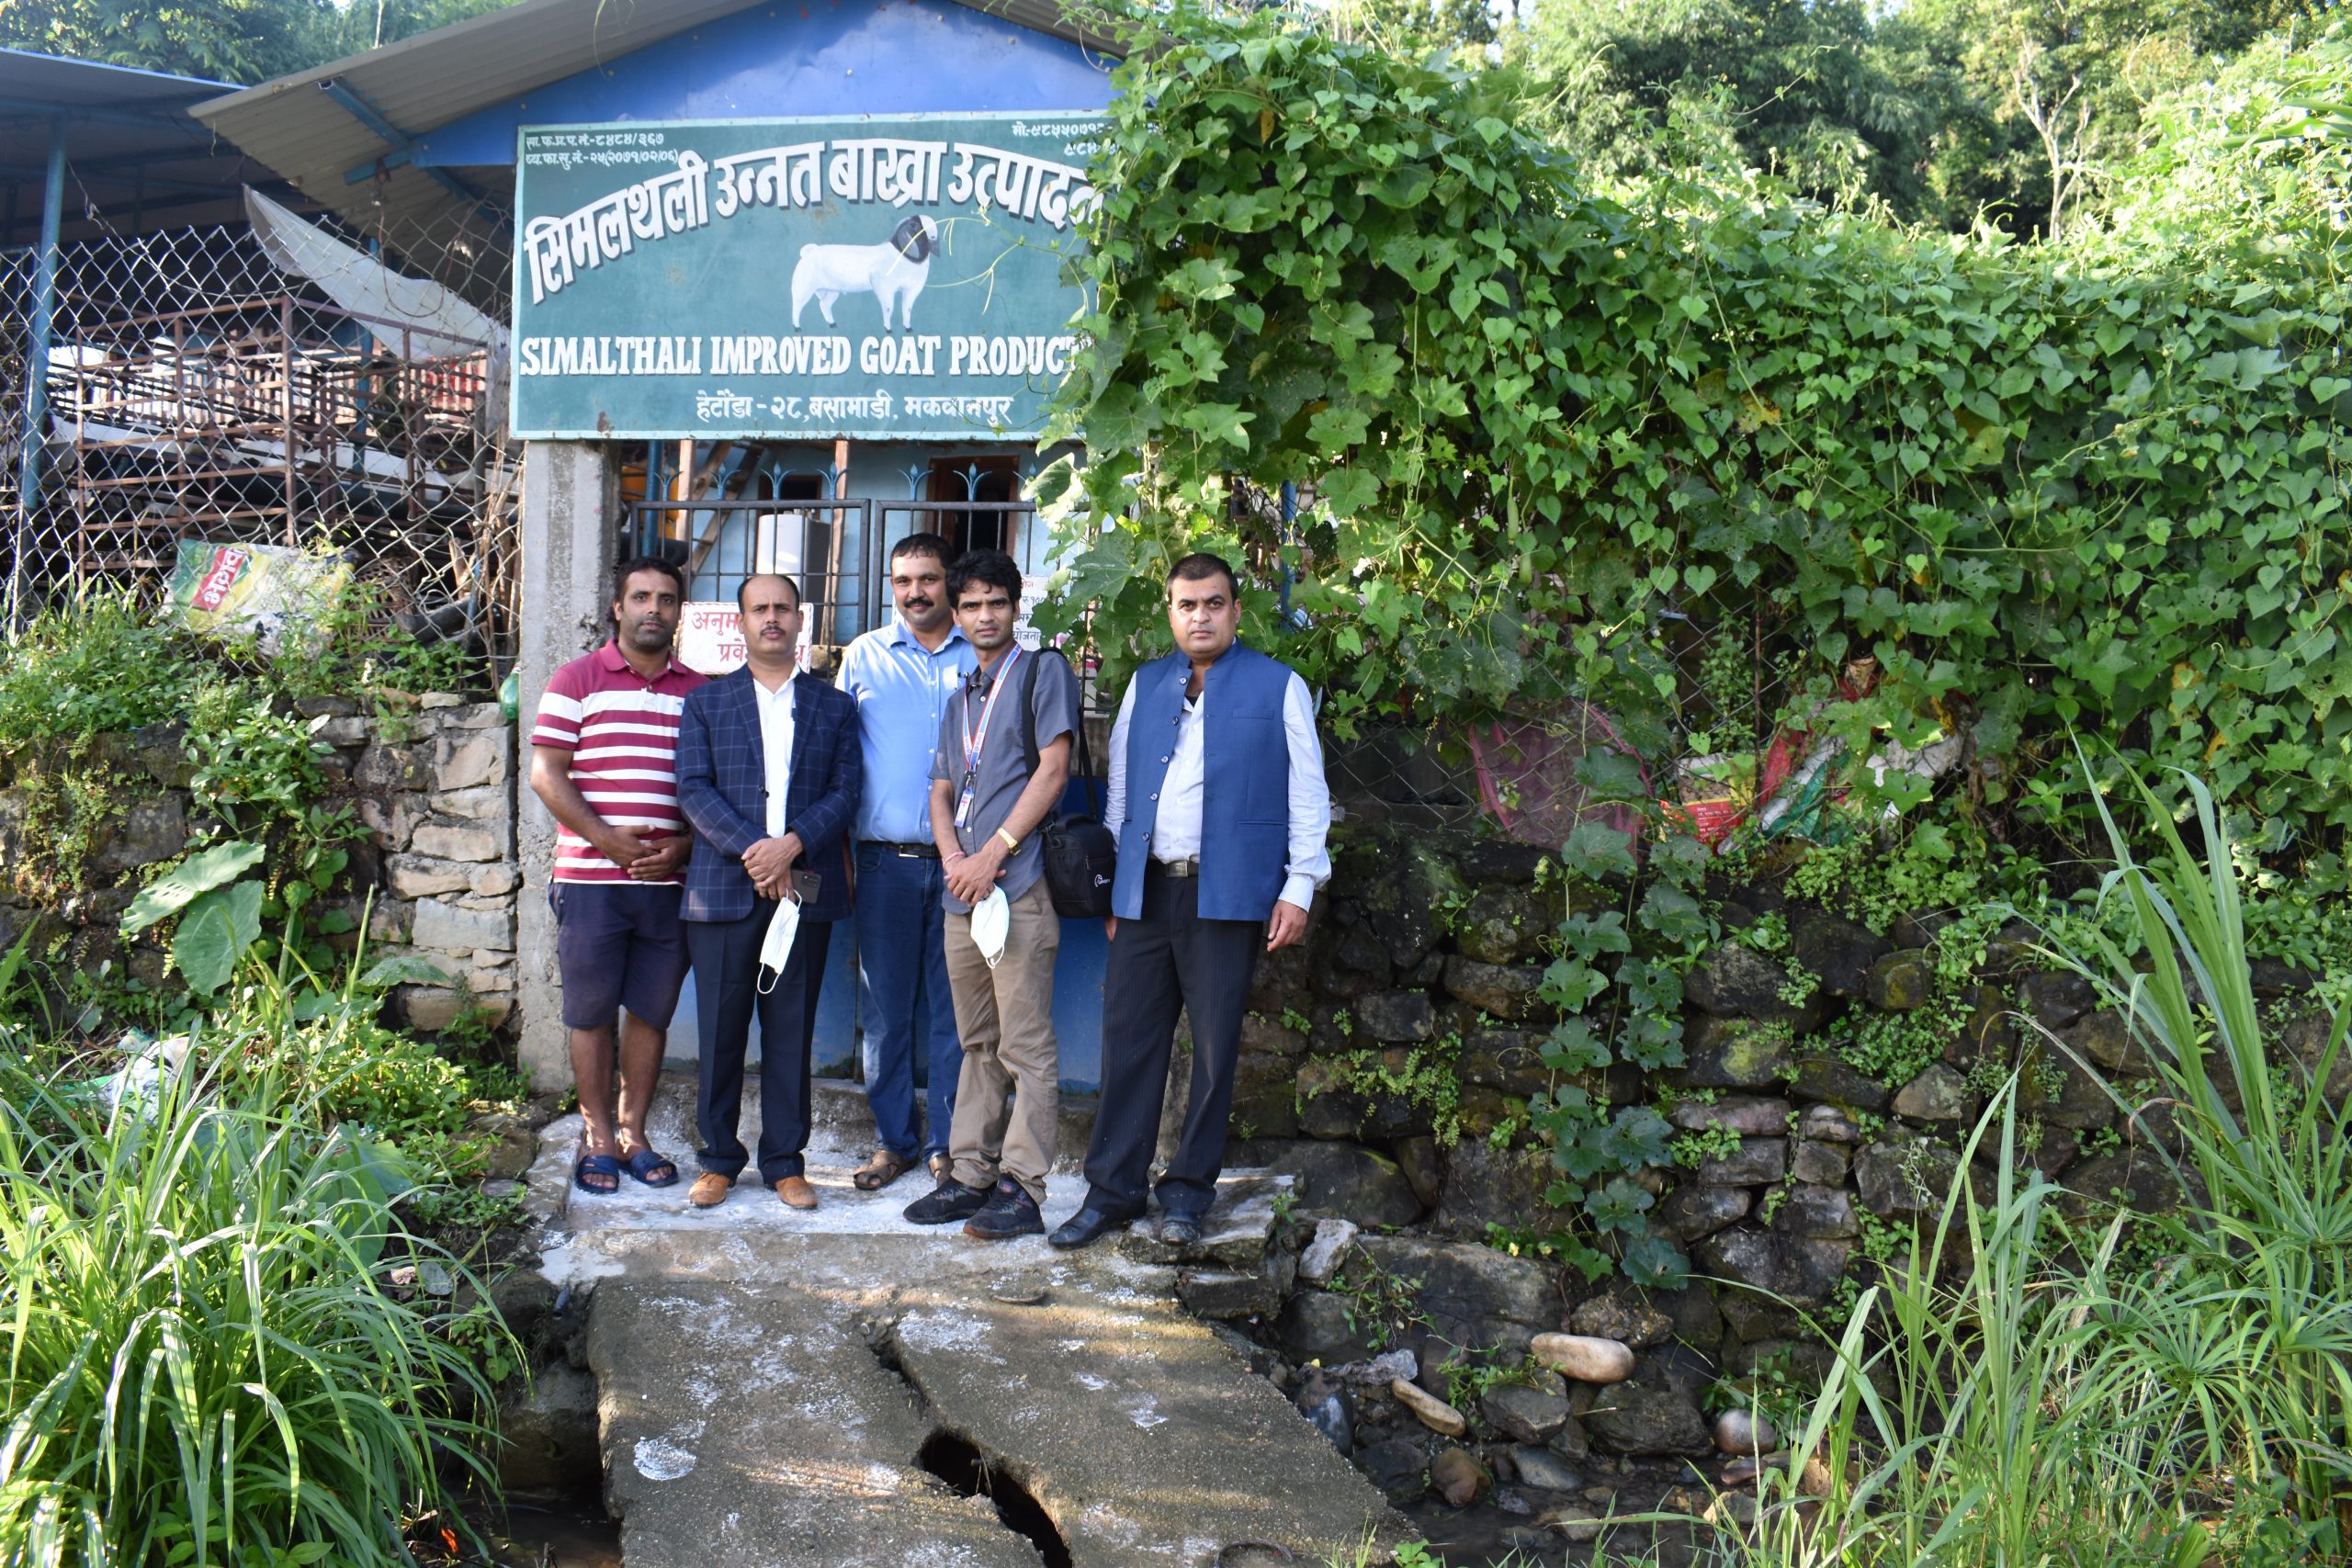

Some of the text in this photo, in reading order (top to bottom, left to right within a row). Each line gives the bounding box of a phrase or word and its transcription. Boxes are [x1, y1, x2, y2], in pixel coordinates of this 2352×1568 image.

[524, 150, 708, 305] सिमलथली
[714, 141, 825, 218] उन्नत
[829, 139, 948, 209] बाख्रा
[520, 336, 703, 376] SIMALTHALI
[709, 335, 852, 376] IMPROVED
[860, 335, 942, 376] GOAT
[904, 396, 1014, 429] मकवानपुर
[717, 638, 748, 662] प्रवे
